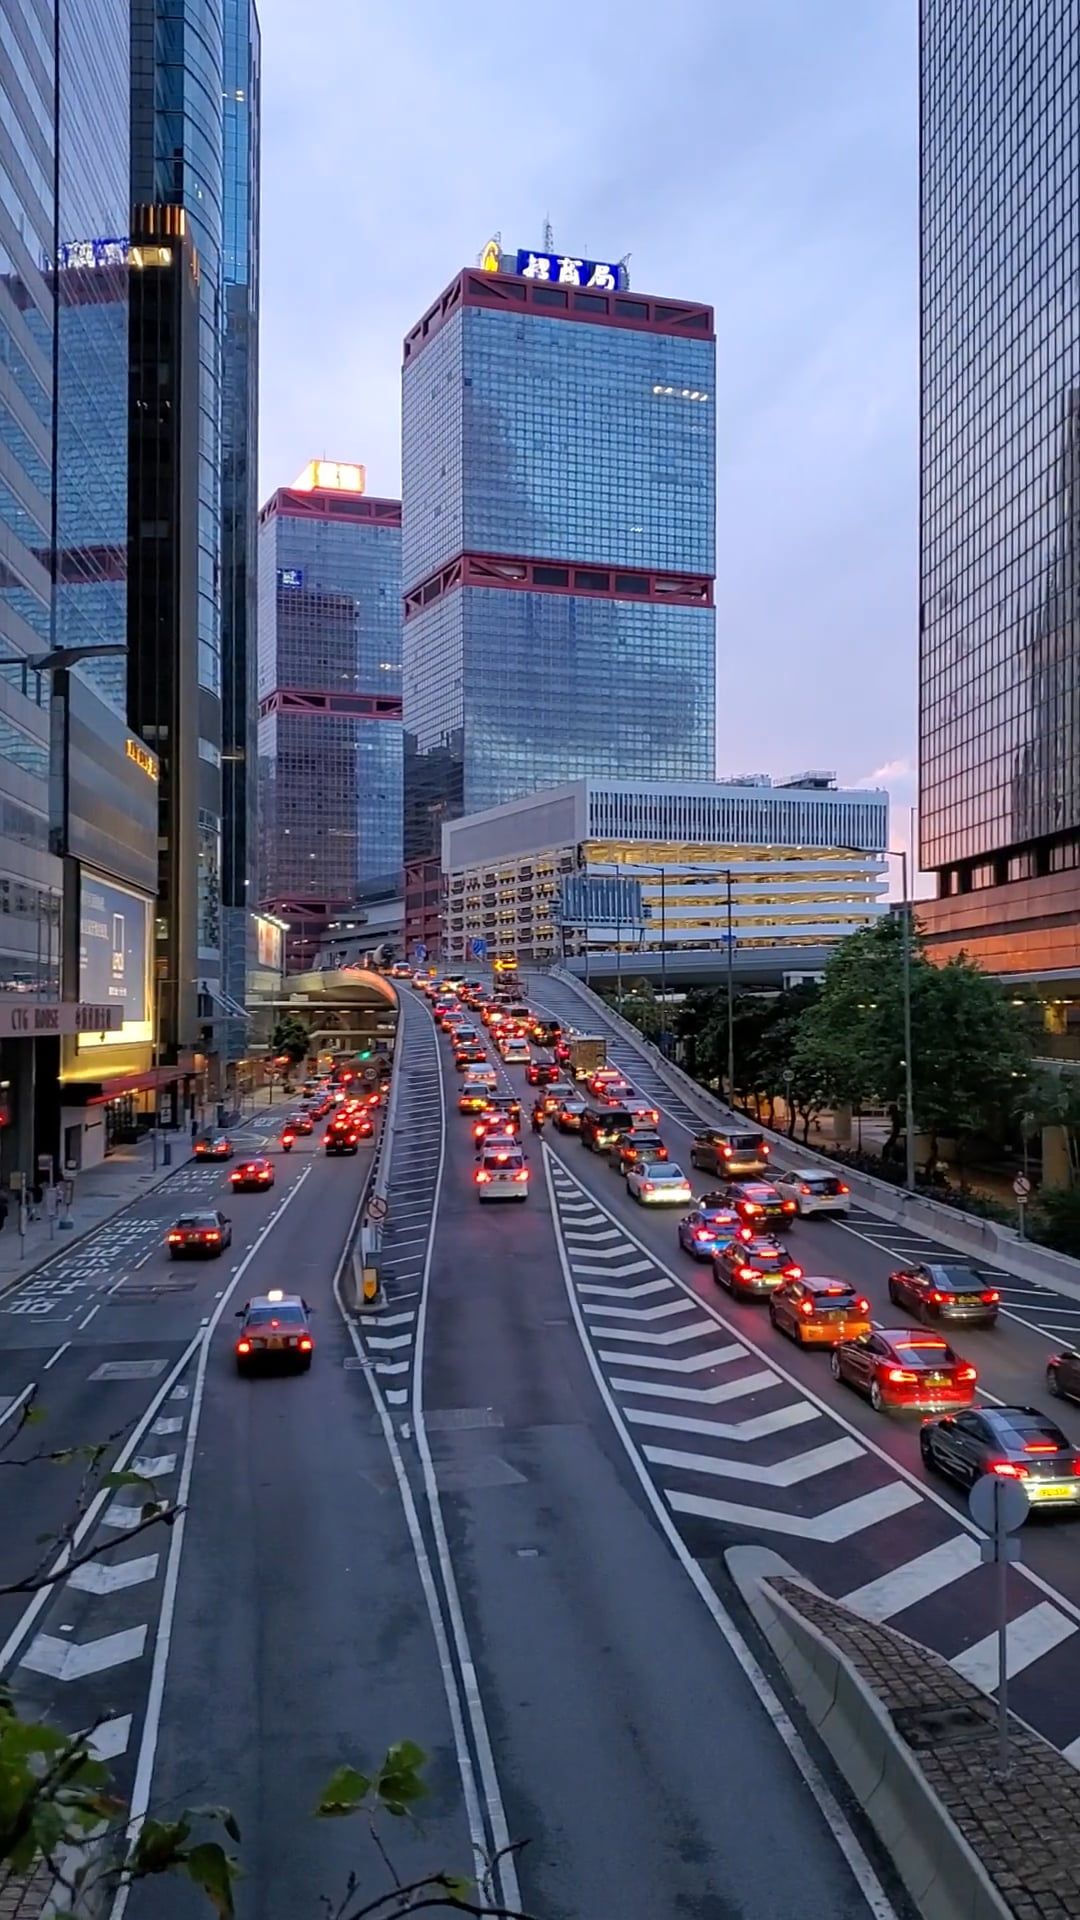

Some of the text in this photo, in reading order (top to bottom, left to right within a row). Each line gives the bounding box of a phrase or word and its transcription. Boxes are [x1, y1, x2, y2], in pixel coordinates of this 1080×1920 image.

[522, 253, 615, 290] 招商局
[88, 1233, 143, 1245] 巴士
[17, 1279, 87, 1296] 巴士
[1, 1297, 63, 1314] 站
